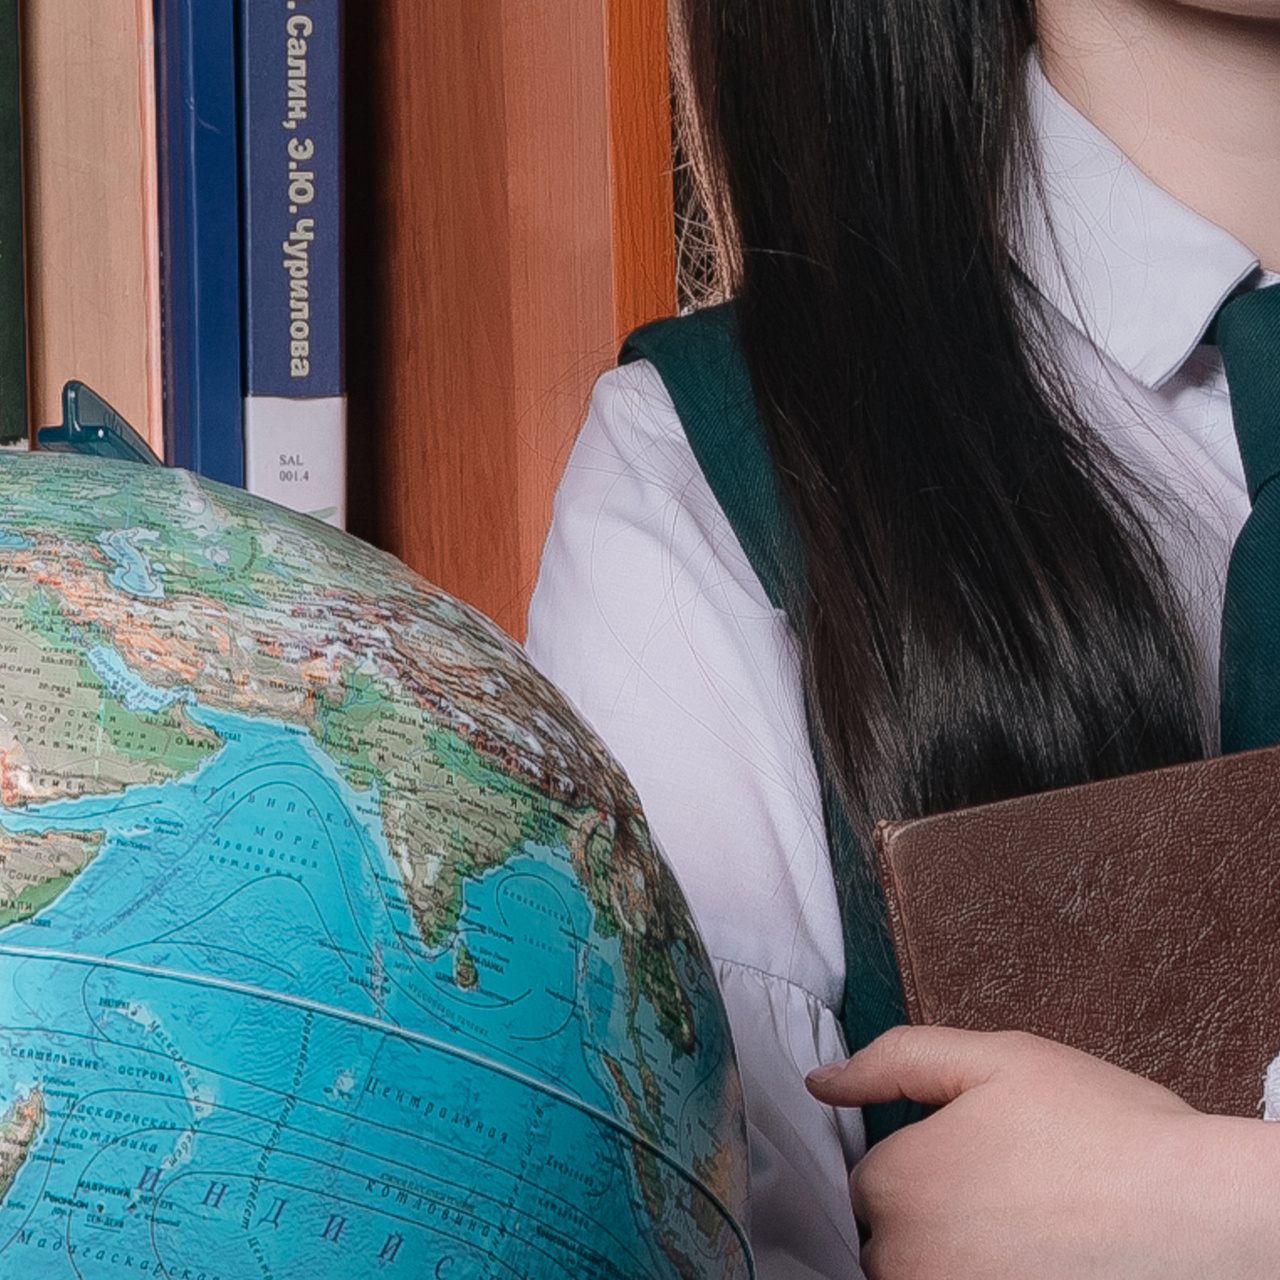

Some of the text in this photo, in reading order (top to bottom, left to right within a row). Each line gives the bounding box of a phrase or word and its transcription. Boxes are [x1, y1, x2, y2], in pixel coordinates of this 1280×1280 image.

[282, 14, 314, 130] Салин,
[287, 137, 315, 214] Э.Ю.
[283, 218, 314, 378] Чурилова
[279, 454, 304, 466] SAL
[279, 470, 309, 481] 001.4
[117, 1064, 174, 1085] ОСТРОВА
